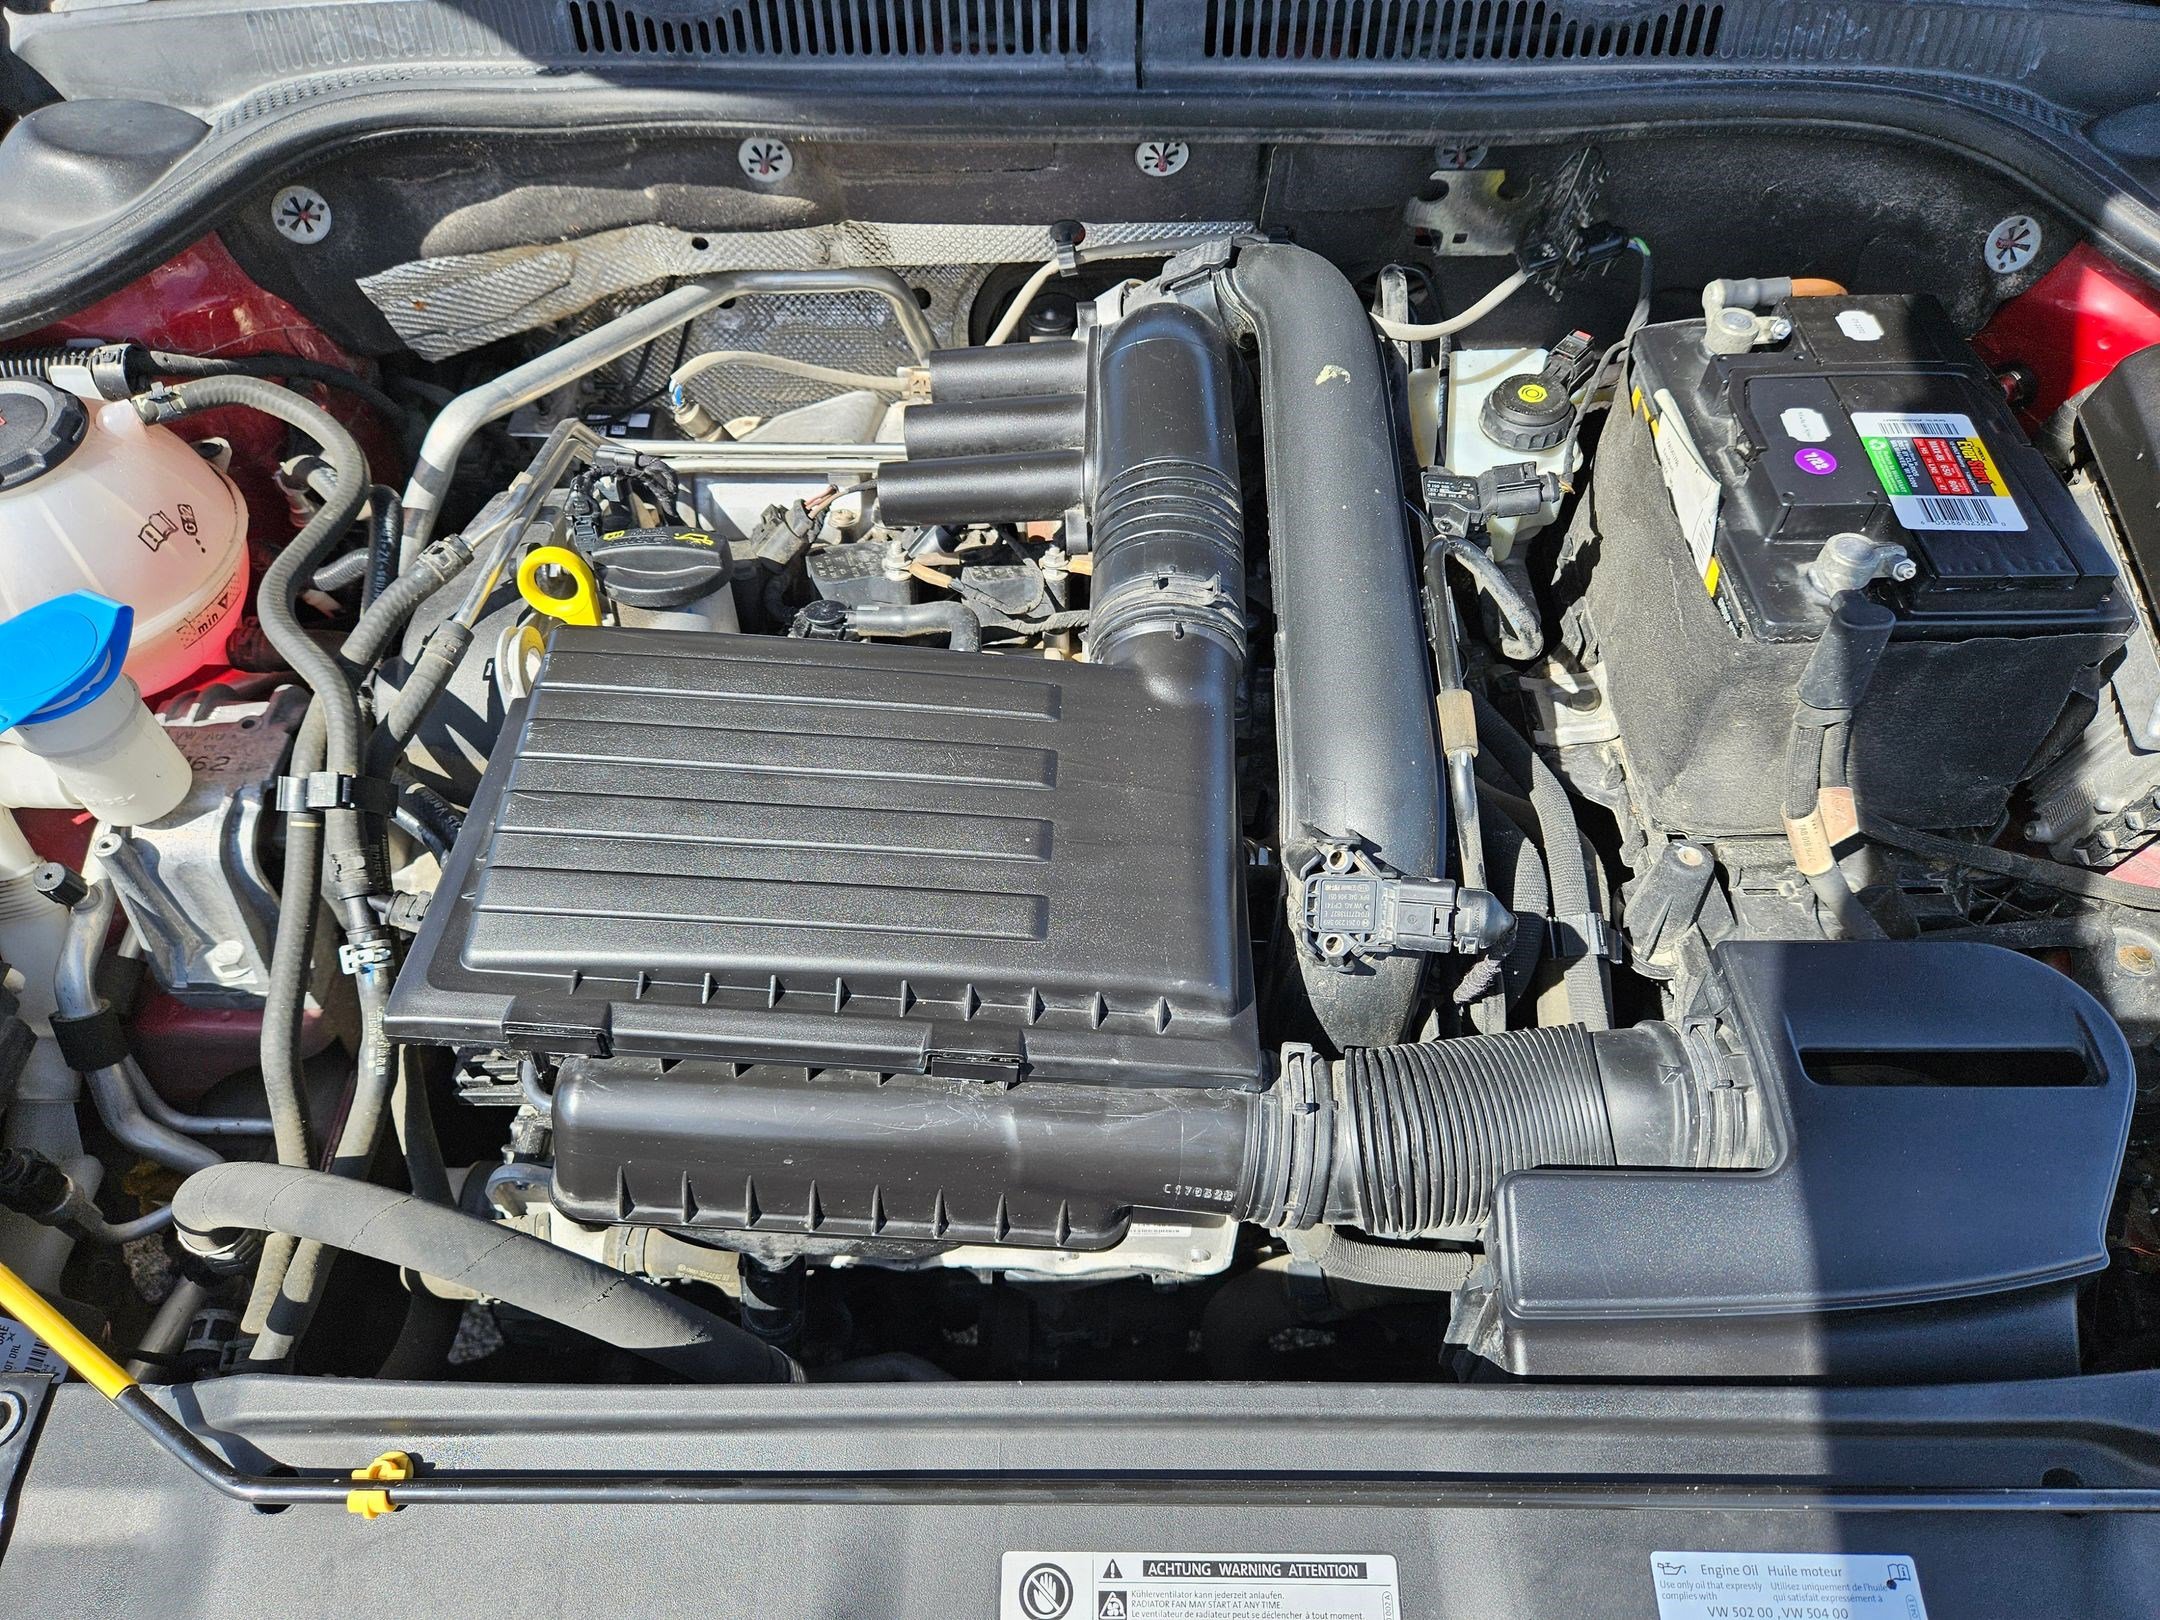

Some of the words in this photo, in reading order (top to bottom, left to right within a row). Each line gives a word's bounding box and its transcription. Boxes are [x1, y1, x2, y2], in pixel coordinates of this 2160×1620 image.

[1956, 440, 1994, 484] EverStart
[1940, 464, 1953, 476] 650
[198, 612, 218, 634] min
[9, 1344, 21, 1359] DRL
[1148, 1562, 1210, 1576] ACHTUNG
[1219, 1562, 1282, 1577] WARNING
[1288, 1563, 1358, 1578] ATTENTION
[1701, 1565, 1740, 1579] Engine
[1742, 1565, 1759, 1576] Oil
[1768, 1565, 1798, 1577] Huile
[1801, 1566, 1842, 1577] moteur
[1659, 1580, 1675, 1589] Use
[1677, 1580, 1694, 1591] only
[1695, 1581, 1705, 1589] oil
[1707, 1581, 1723, 1590] that
[1725, 1582, 1762, 1592] expressly
[1770, 1583, 1800, 1591] Utilisez
[1802, 1583, 1850, 1593] uniquement
[1852, 1583, 1862, 1592] de
[1131, 1590, 1192, 1599] Kühlerventilator
[1194, 1590, 1213, 1599] kann
[1214, 1591, 1247, 1601] jederzeit
[1249, 1591, 1285, 1600] anlaufen.
[1662, 1592, 1698, 1602] complies
[1699, 1592, 1718, 1601] with
[1773, 1594, 1786, 1603] qui
[1787, 1594, 1818, 1603] satisfait
[1131, 1600, 1170, 1608] RADIATOR
[1172, 1600, 1186, 1608] FAN
[1189, 1600, 1206, 1608] MAY
[1208, 1600, 1230, 1609] START
[1244, 1601, 1259, 1609] ANY
[1131, 1610, 1140, 1618] Le
[1142, 1610, 1182, 1618] ventilateur
[1185, 1610, 1194, 1618] de
[1195, 1610, 1230, 1619] radiateur
[1233, 1611, 1249, 1620] peut
[1262, 1611, 1303, 1620] déclencher
[1305, 1611, 1310, 1620] à
[1312, 1612, 1328, 1620] tout
[1707, 1606, 1729, 1618] VW
[1732, 1607, 1754, 1618] 502
[1757, 1607, 1773, 1618] 00
[1807, 1608, 1830, 1619] 504
[1832, 1608, 1849, 1620] 00
